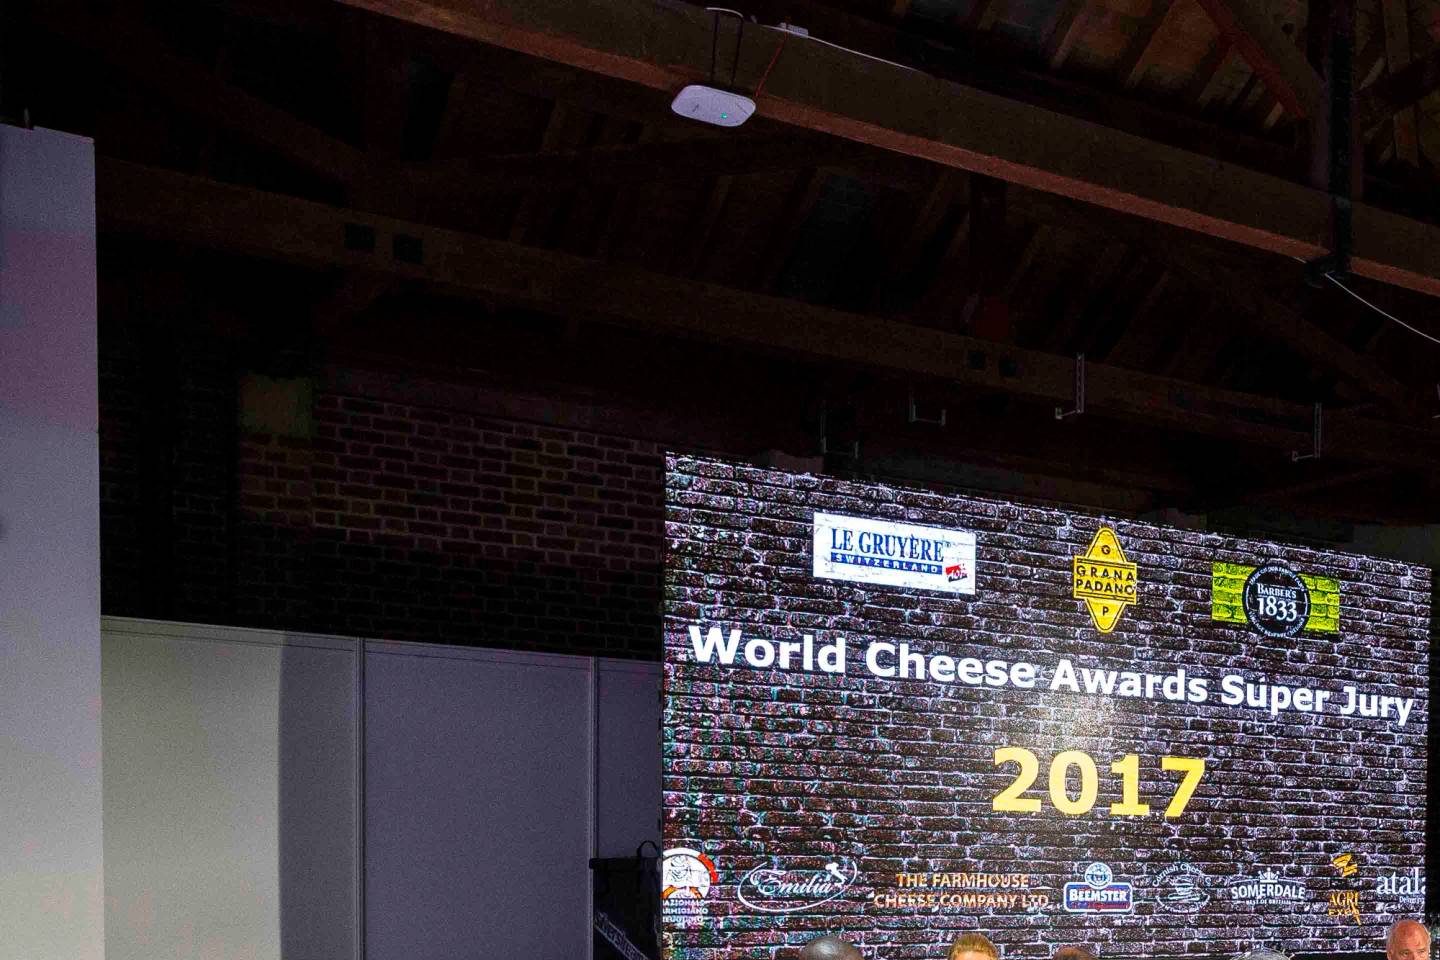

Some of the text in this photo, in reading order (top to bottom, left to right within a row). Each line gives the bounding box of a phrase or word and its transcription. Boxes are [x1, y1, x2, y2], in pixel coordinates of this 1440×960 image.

[830, 528, 945, 563] LE GRUYÈRE
[1101, 543, 1111, 555] G
[835, 553, 939, 574] SWITZERLAND
[1076, 564, 1135, 583] GRANA
[1076, 578, 1135, 597] PADANO
[1102, 605, 1109, 617] P
[1257, 596, 1298, 622] 1833
[688, 624, 1414, 726] World Cheese Awards Super Jury
[992, 747, 1205, 817] 2017
[751, 868, 833, 896] Emilia
[897, 873, 1030, 888] THE FARMHOUSE
[1152, 864, 1179, 888] Cornish
[873, 894, 1049, 908] CHEESE COMPANY LTD
[1069, 889, 1128, 902] BEEMSTER
[1231, 884, 1306, 900] SOMERDALE
[1329, 892, 1359, 906] AGRI
